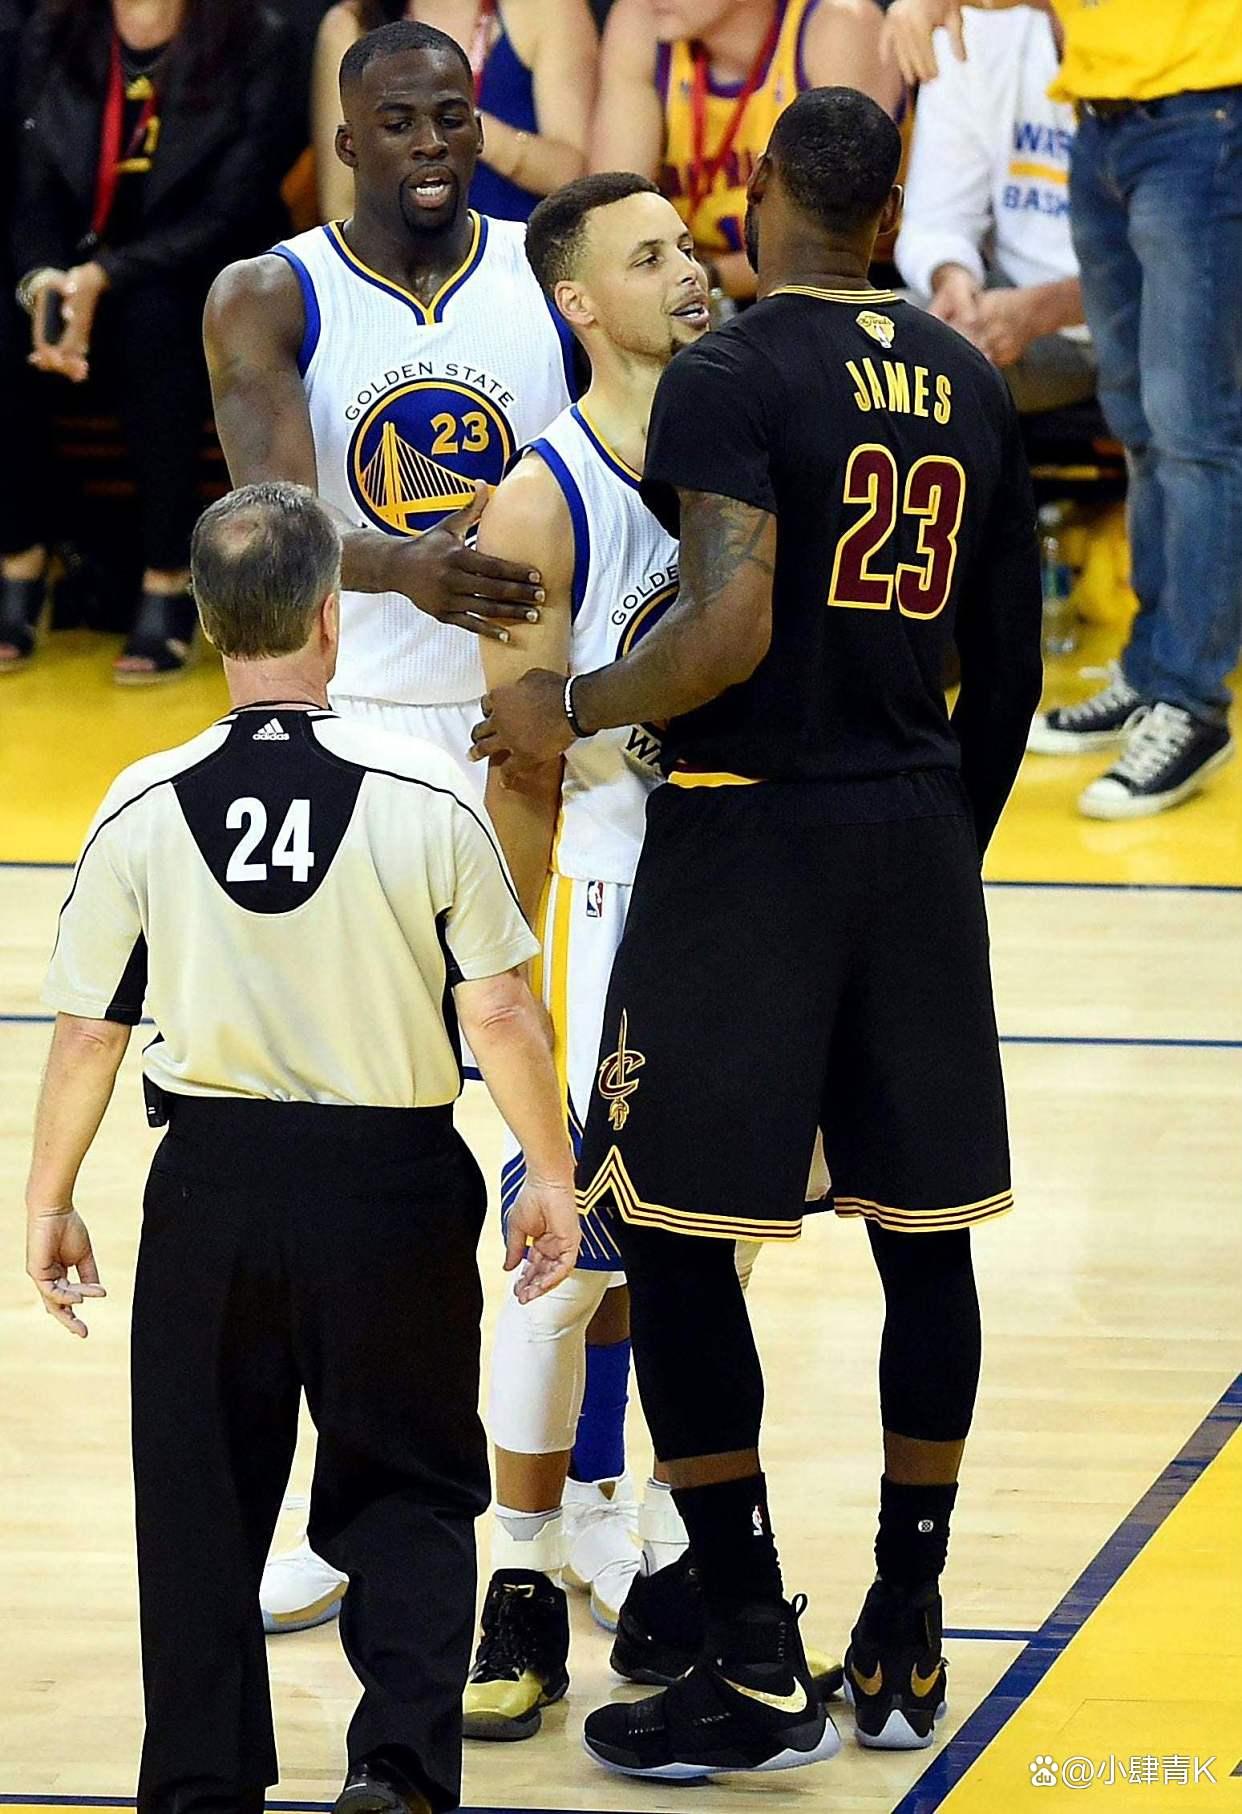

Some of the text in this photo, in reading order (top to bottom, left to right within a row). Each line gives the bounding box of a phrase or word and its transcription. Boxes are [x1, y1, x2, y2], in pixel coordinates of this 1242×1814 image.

[345, 361, 515, 421] GOLDEN STATE
[845, 357, 951, 424] JAMES
[430, 411, 490, 455] 23
[827, 443, 966, 620] 23
[611, 565, 679, 626] GOLDE
[225, 796, 315, 882] 24
